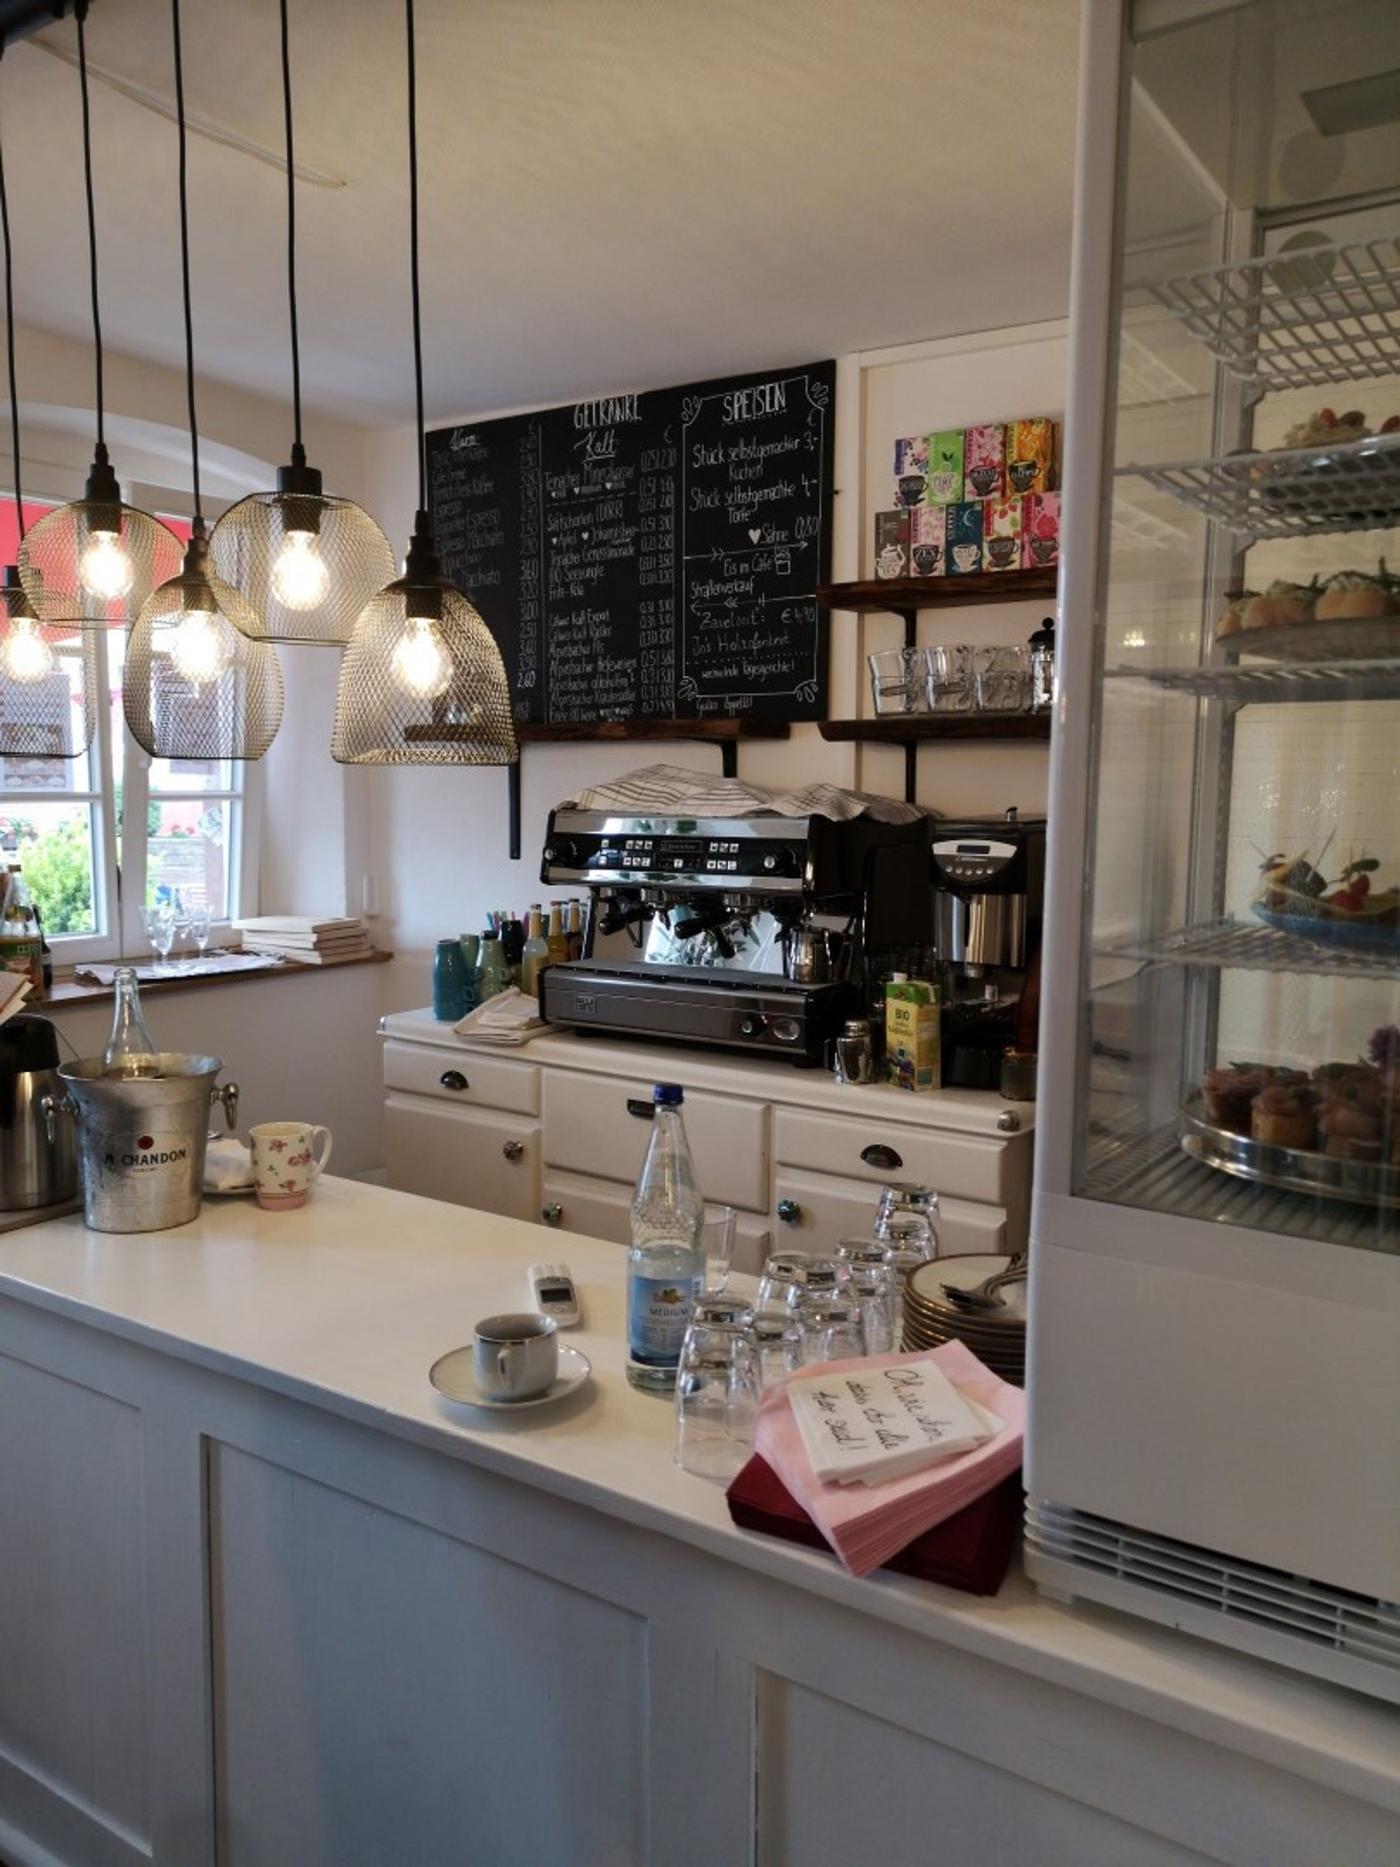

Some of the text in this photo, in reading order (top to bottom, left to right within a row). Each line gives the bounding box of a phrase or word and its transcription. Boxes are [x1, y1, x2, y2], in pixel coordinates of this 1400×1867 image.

[722, 382, 786, 422] SPEISEN
[692, 441, 725, 468] Stück
[728, 460, 765, 482] Kuchen
[689, 487, 721, 512] Stück
[727, 505, 752, 524] Torte
[121, 1148, 187, 1167] CHANDON
[649, 1307, 689, 1317] MEDIUM
